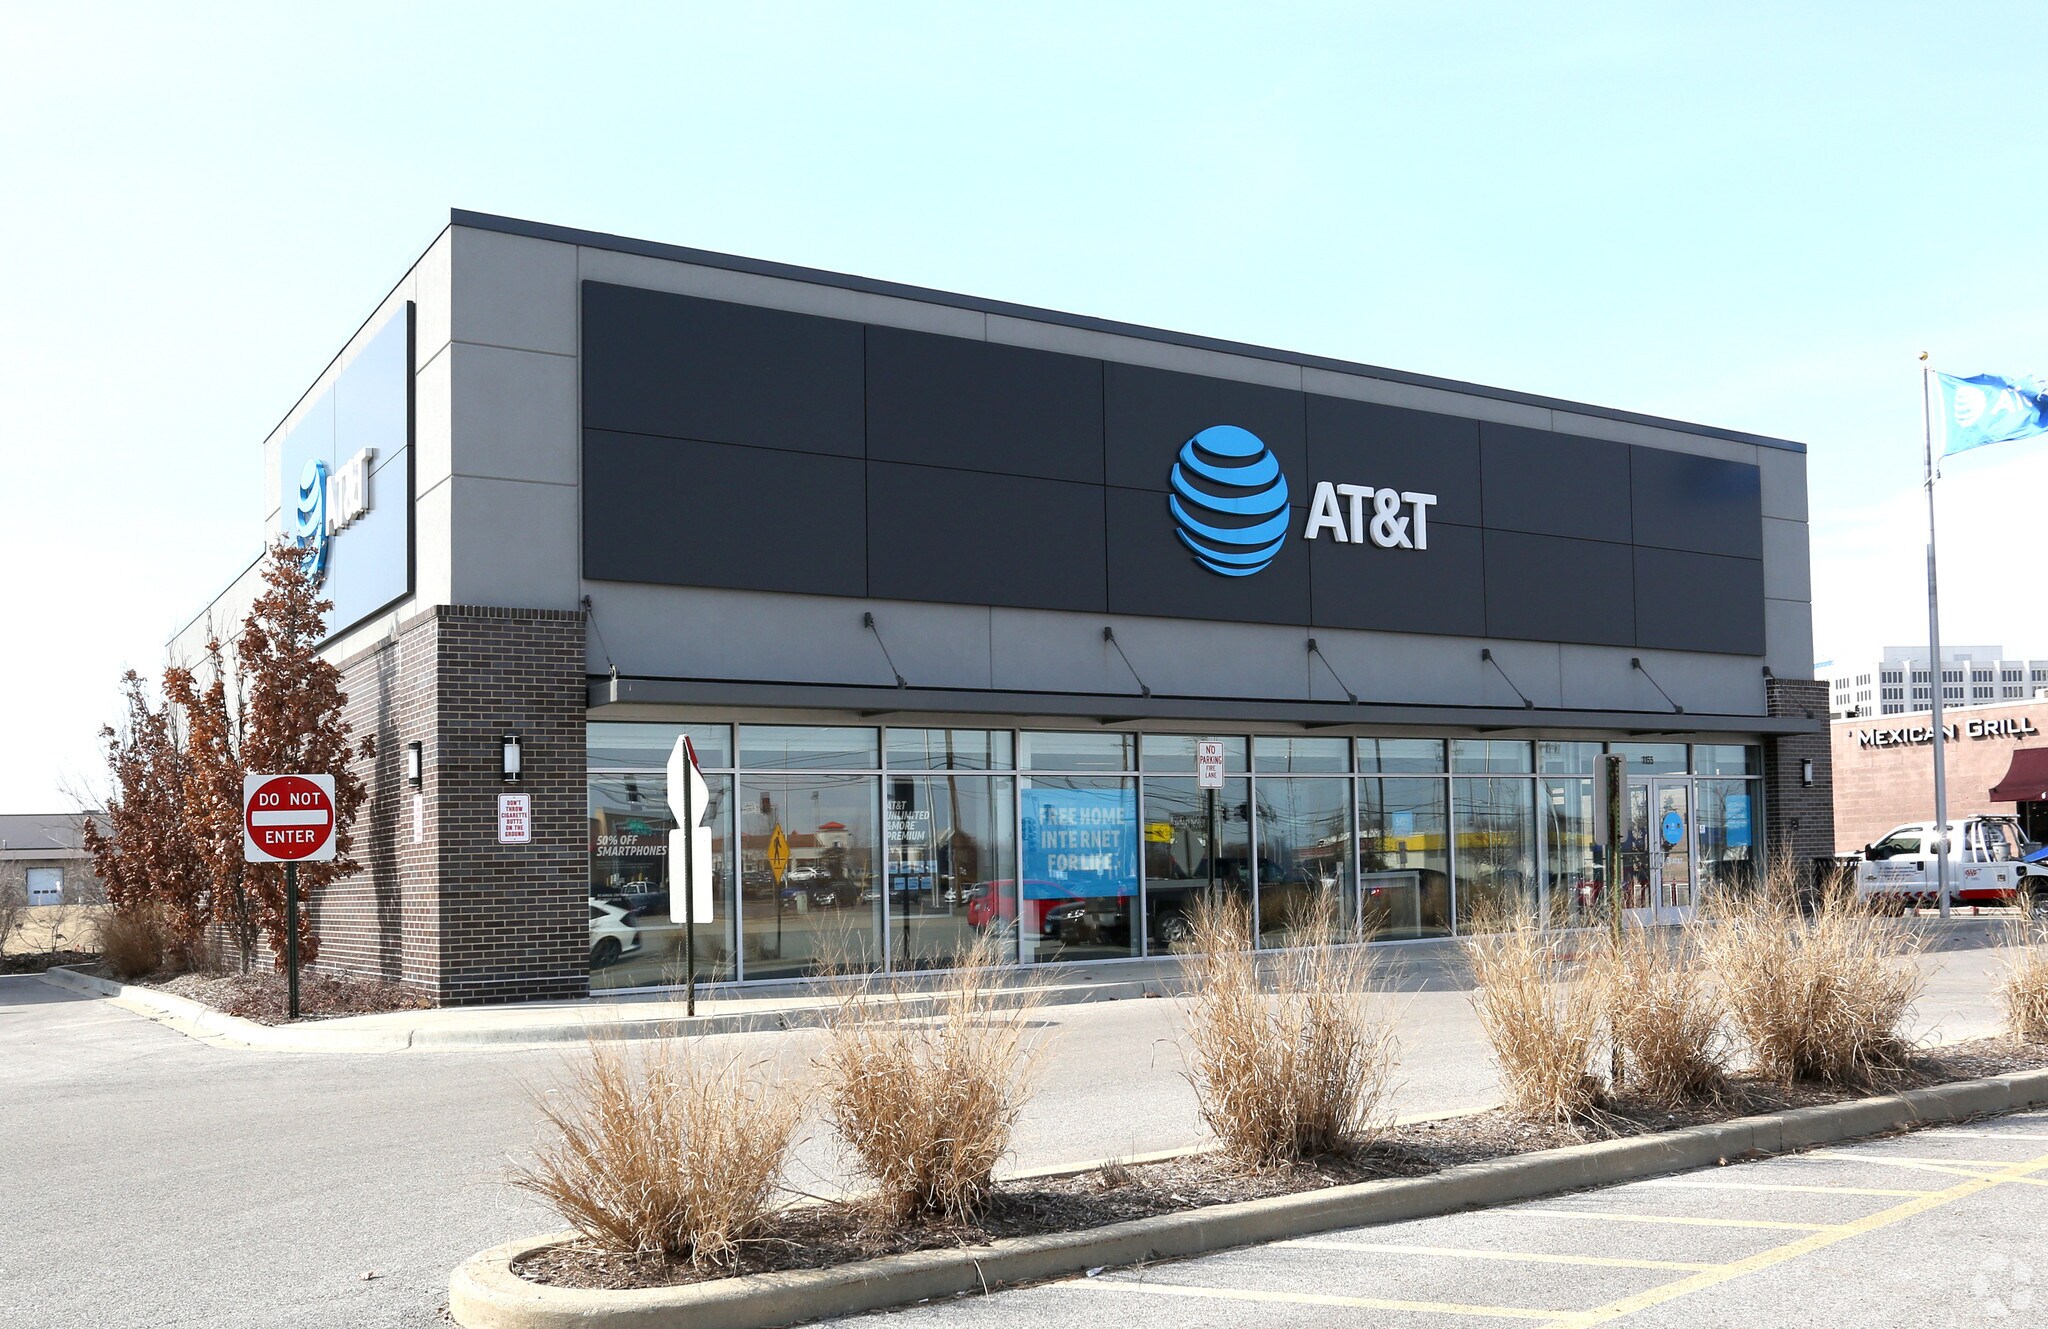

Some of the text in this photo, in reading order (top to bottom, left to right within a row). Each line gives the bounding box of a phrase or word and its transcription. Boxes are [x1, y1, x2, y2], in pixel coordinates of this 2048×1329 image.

[1304, 481, 1437, 550] AT&T
[1857, 717, 2035, 746] MEXICAN GRILL
[1205, 745, 1216, 754] NO
[1200, 756, 1222, 764] PARKING
[259, 792, 321, 806] DO NOT
[1039, 807, 1125, 826] FREE HOME
[265, 830, 315, 844] ENTER
[596, 835, 638, 846] 50% OFF
[887, 831, 925, 840] PREMIUM
[596, 845, 667, 857] SMARTPHONES
[1047, 854, 1078, 871] FOR
